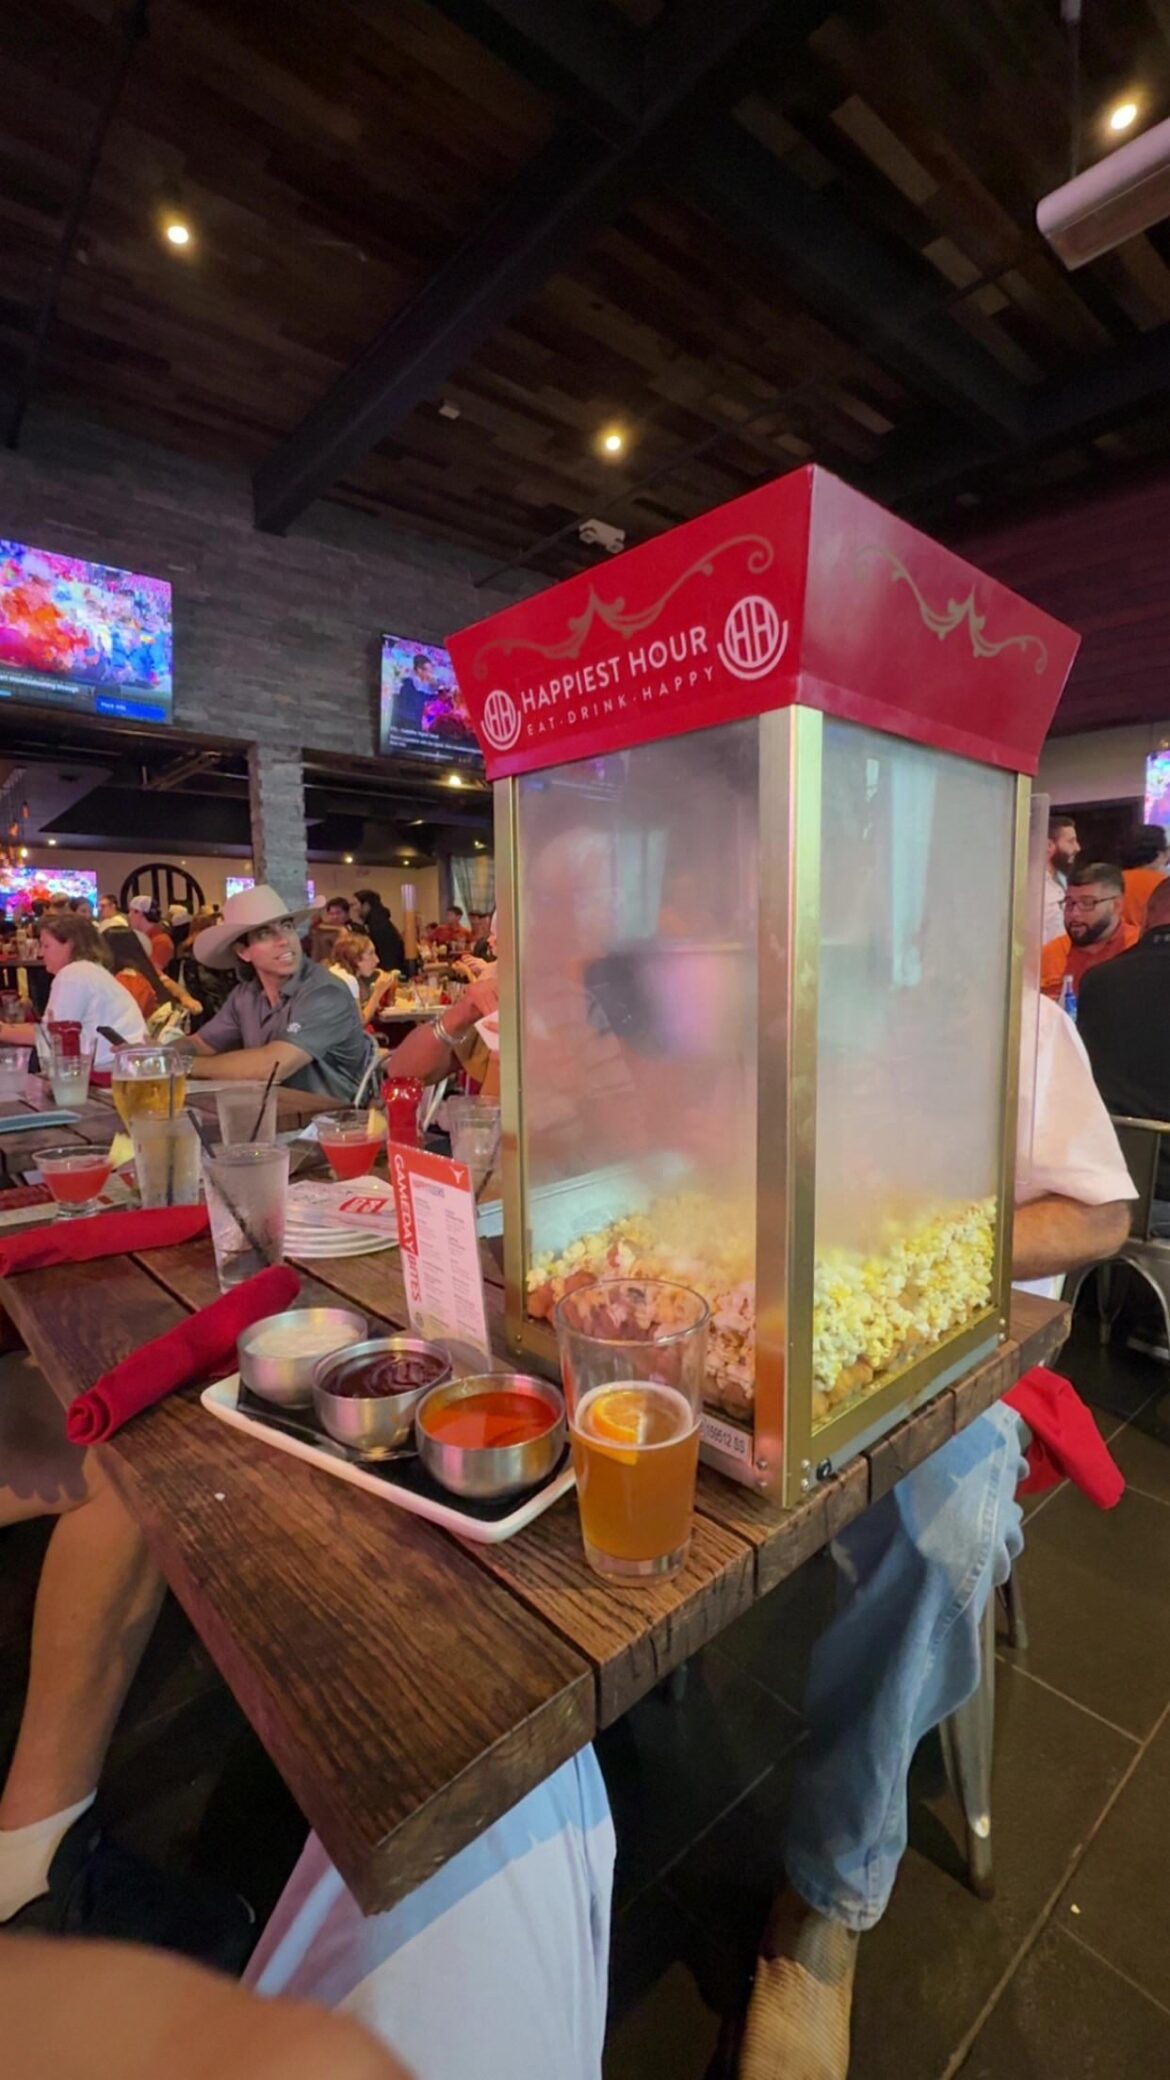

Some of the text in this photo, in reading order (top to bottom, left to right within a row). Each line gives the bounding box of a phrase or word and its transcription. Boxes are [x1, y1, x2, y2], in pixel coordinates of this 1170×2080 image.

[520, 626, 708, 714] HAPPIEST HOUR
[394, 1153, 416, 1254] GAMEDAY
[407, 1254, 422, 1302] BITES
